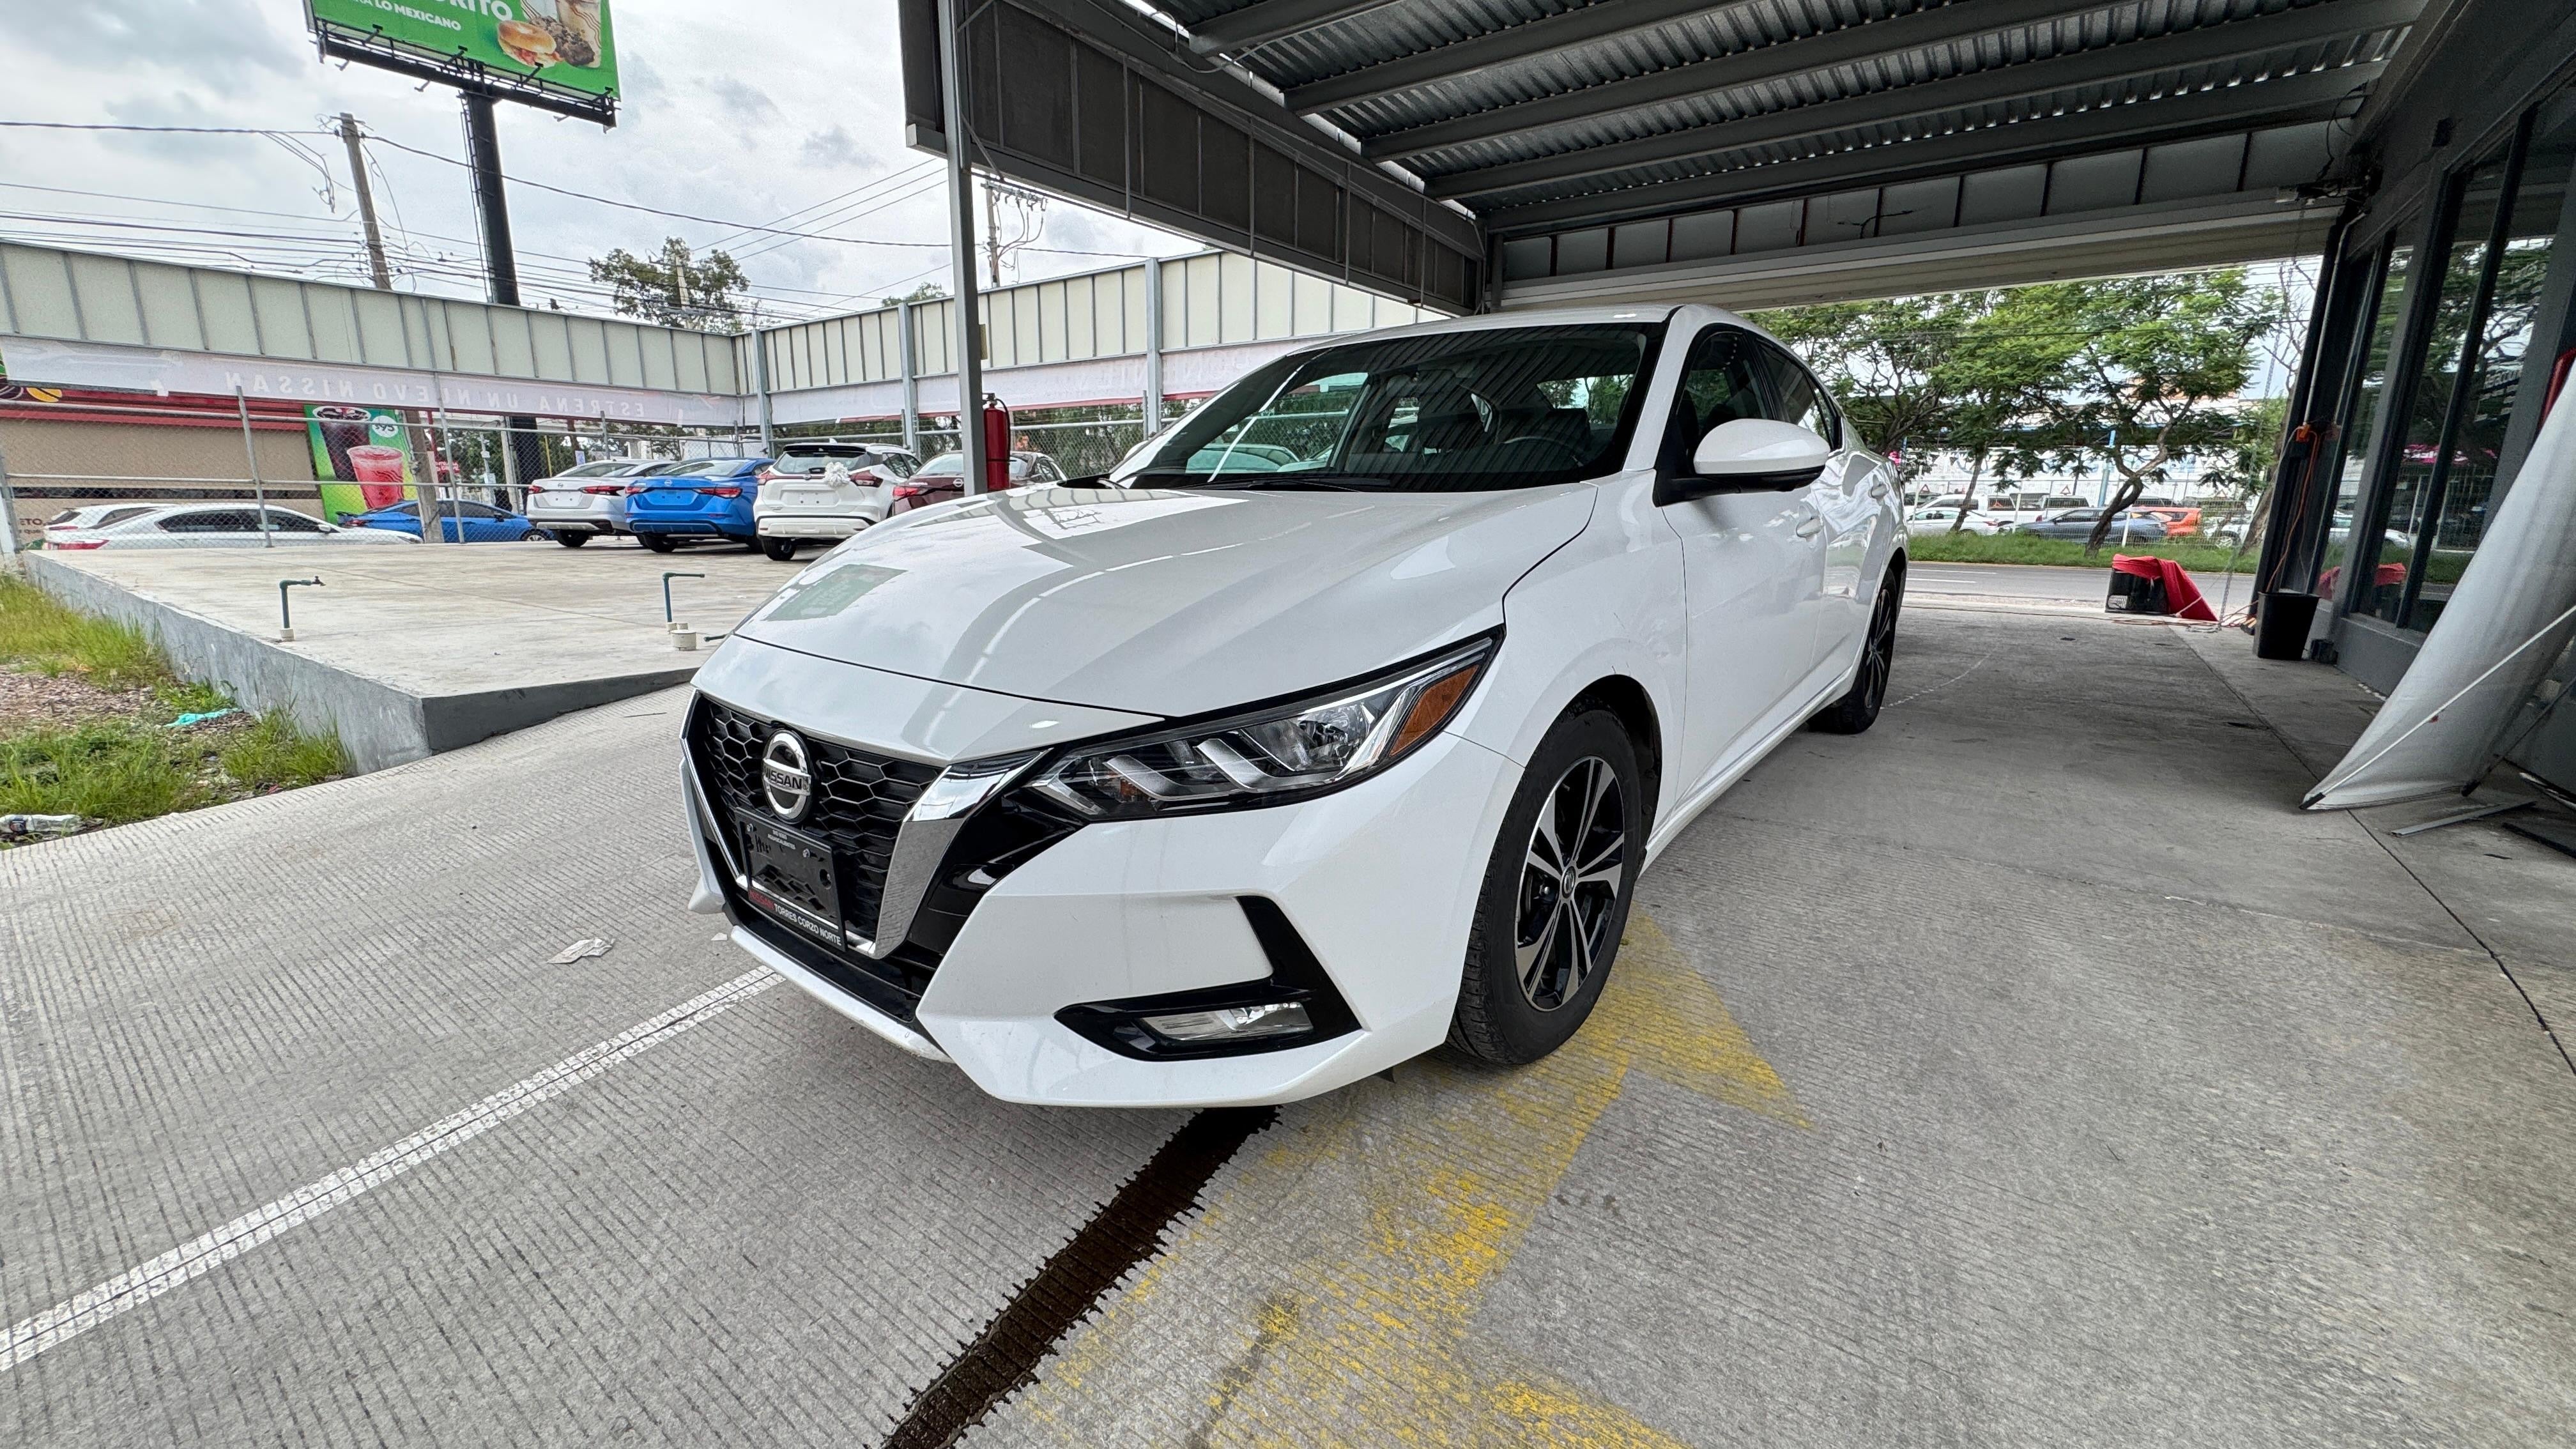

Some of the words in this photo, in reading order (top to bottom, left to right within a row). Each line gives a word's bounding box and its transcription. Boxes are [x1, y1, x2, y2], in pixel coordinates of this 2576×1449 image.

[394, 3, 462, 31] MEXICANO
[763, 765, 802, 790] NISSAN
[774, 903, 798, 923] TORRES
[797, 916, 820, 934] CORZO
[819, 927, 842, 946] NORTE
